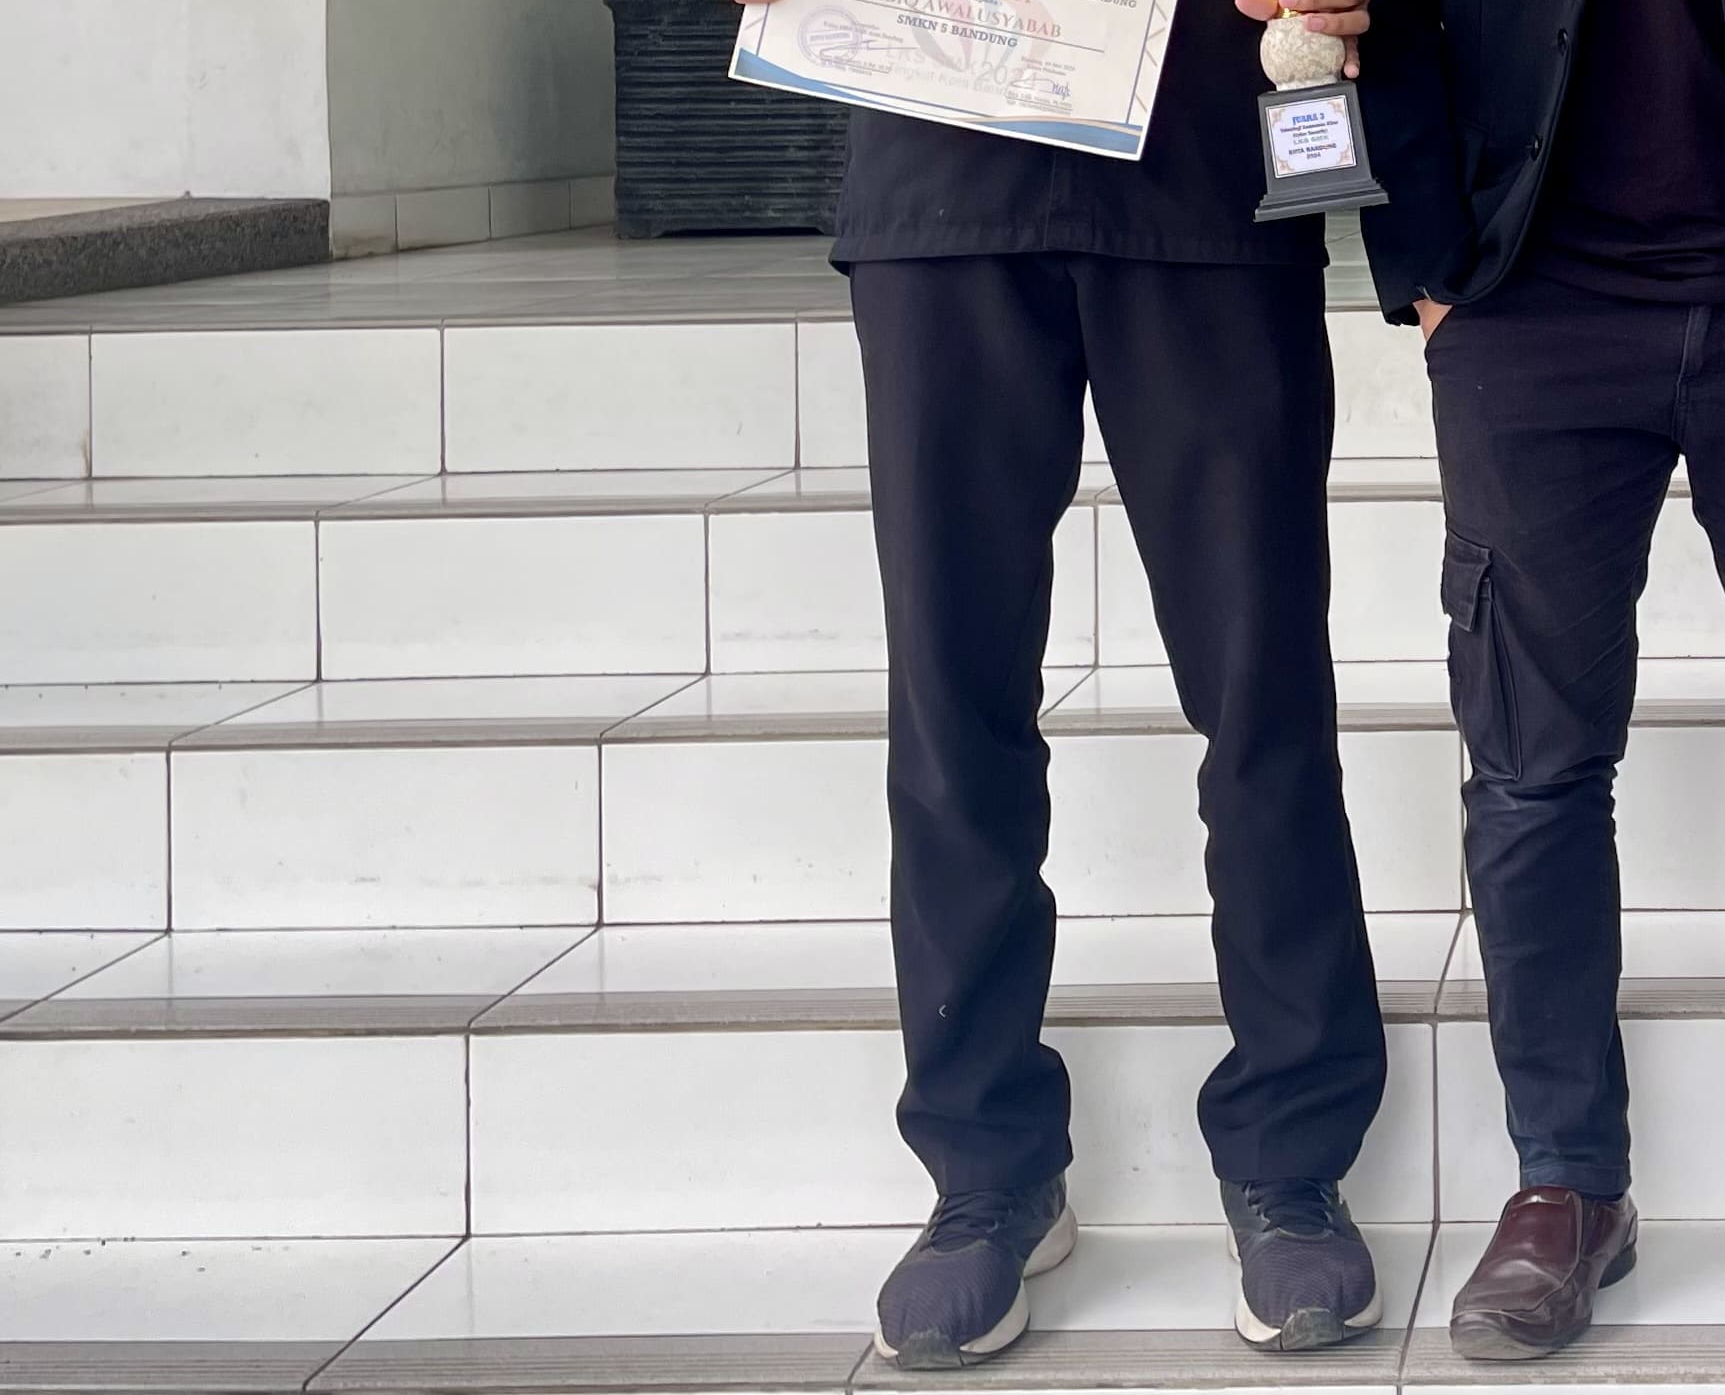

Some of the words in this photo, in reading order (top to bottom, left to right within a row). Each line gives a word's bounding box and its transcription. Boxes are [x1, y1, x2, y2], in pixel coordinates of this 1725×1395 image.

[897, 14, 937, 32] SMKN
[940, 22, 948, 33] 5
[951, 24, 1018, 48] BANDUNG
